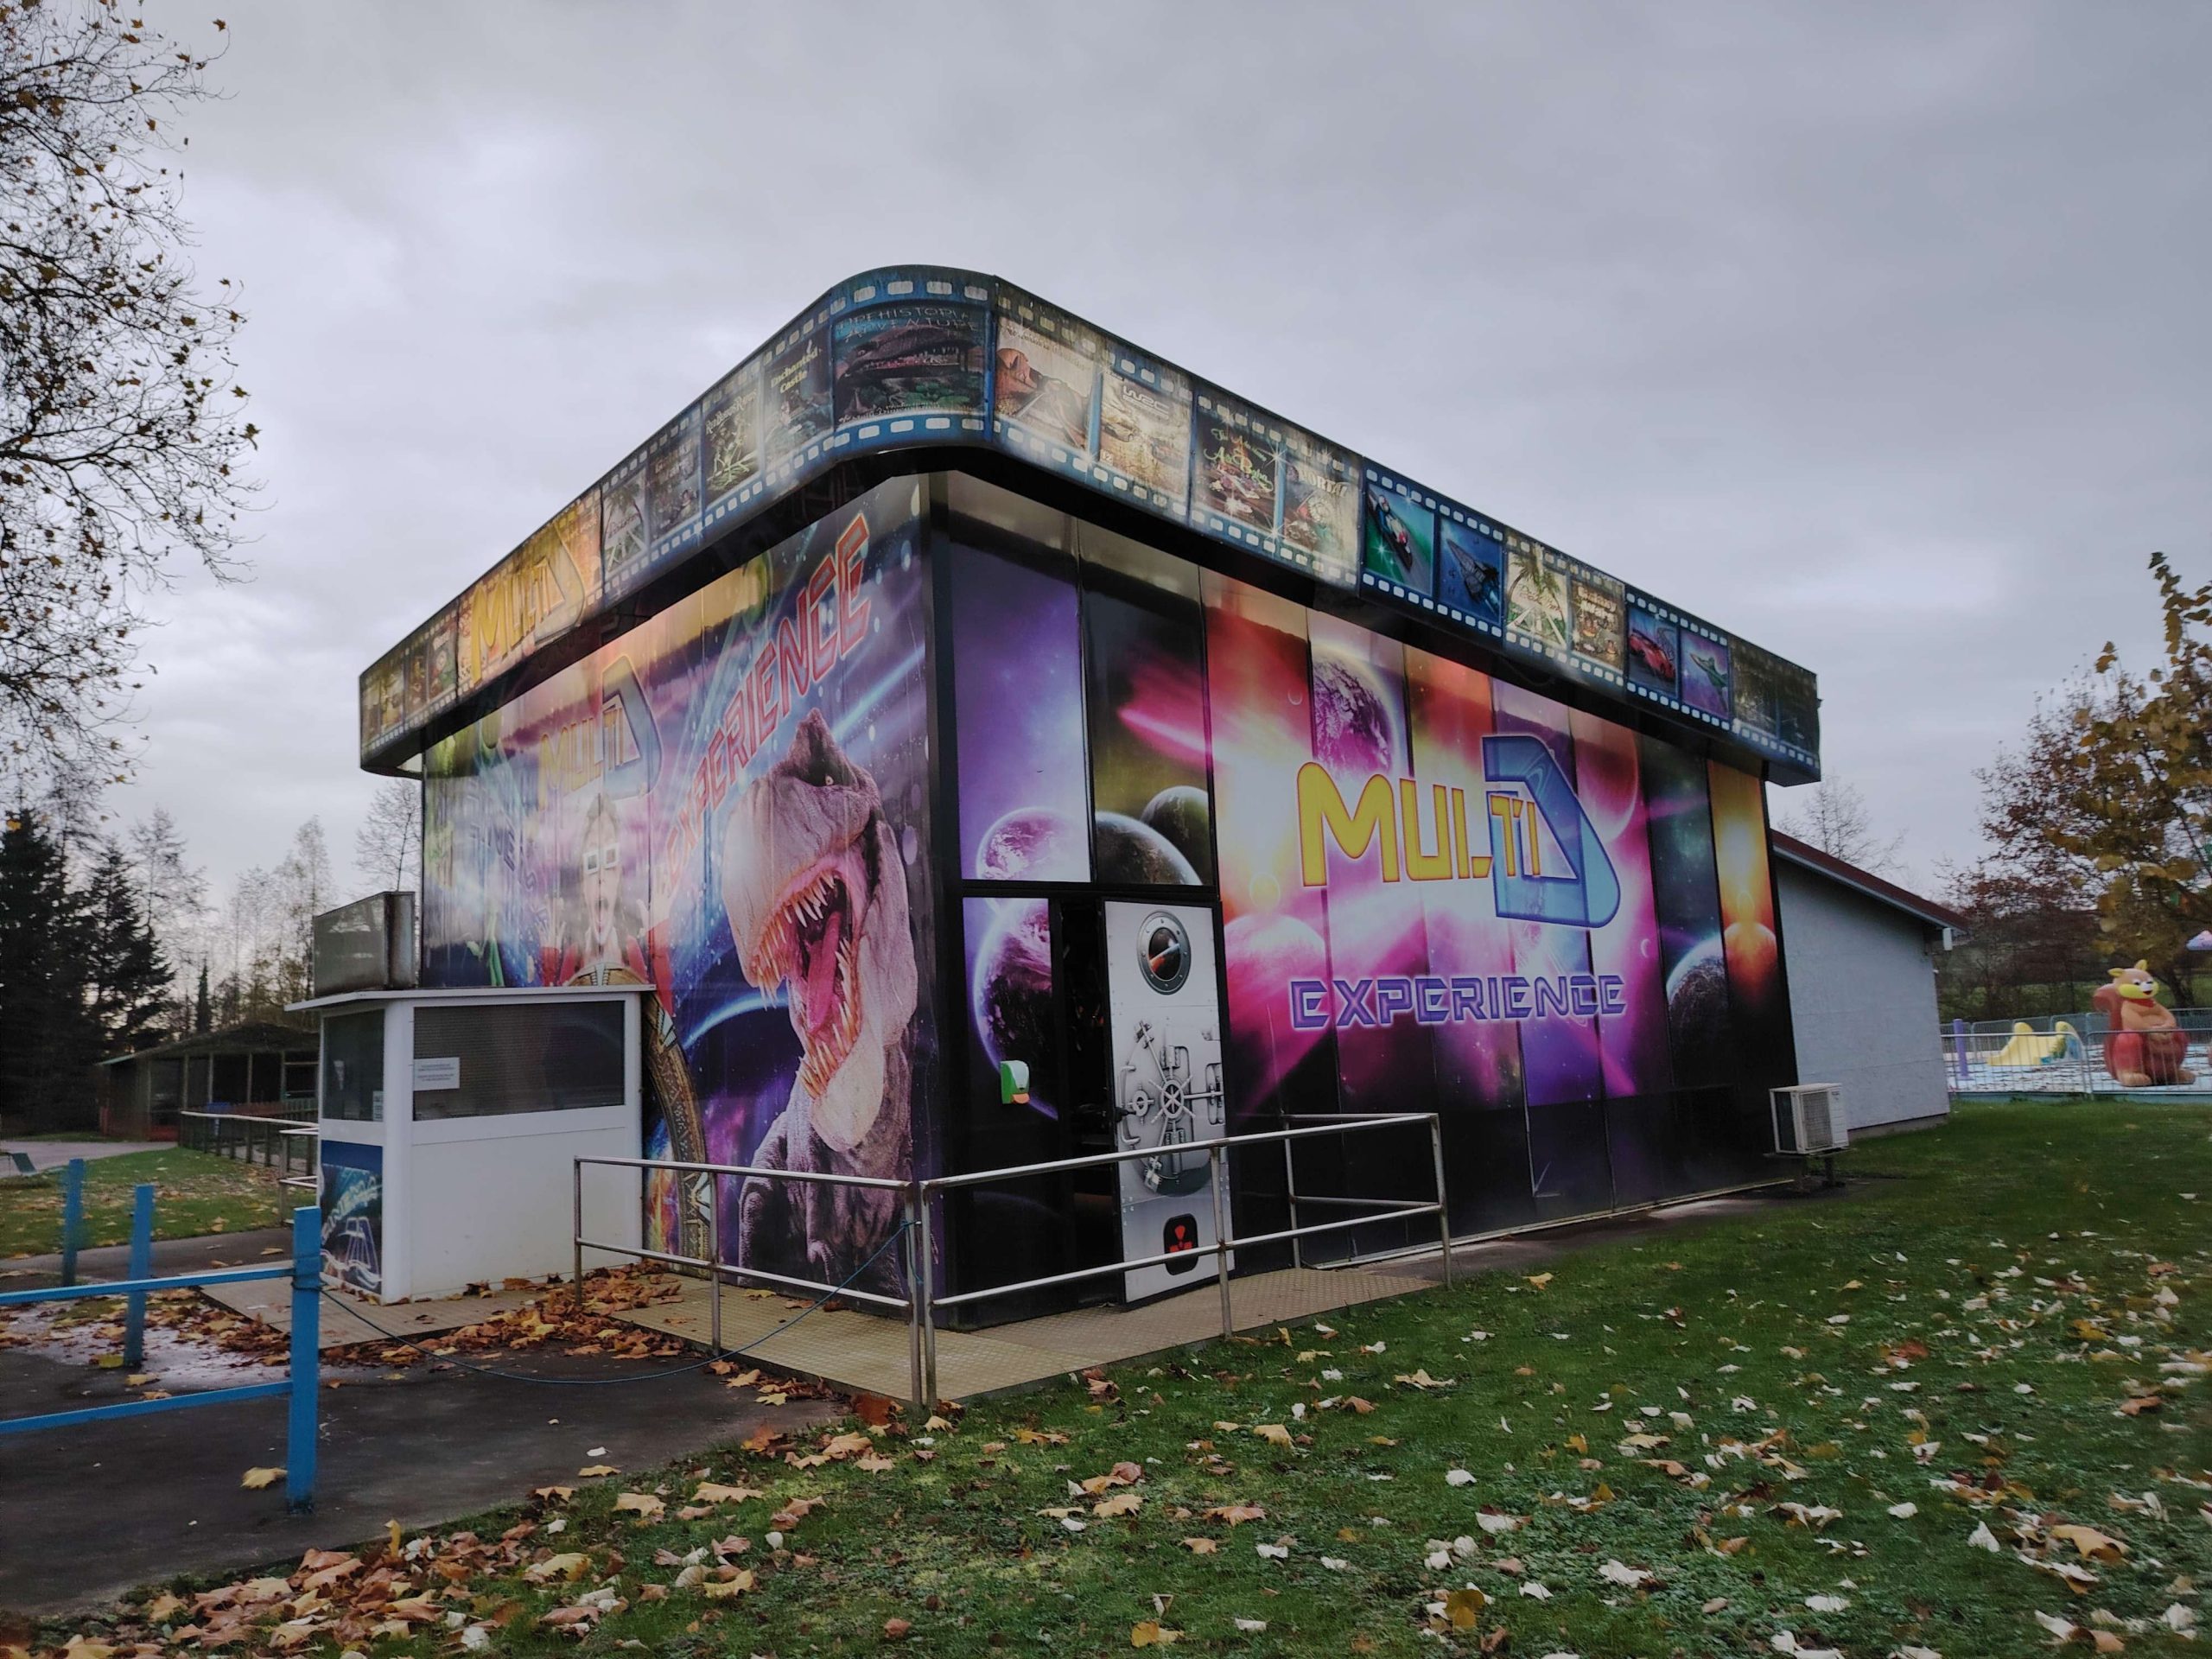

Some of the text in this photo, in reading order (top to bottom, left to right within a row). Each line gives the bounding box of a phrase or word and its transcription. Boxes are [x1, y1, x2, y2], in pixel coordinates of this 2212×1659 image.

[771, 346, 818, 388] Enchanted
[779, 371, 808, 393] Castle
[1122, 385, 1169, 416] WRC
[665, 512, 871, 881] EXPERIENCE
[1296, 760, 1541, 888] MULTI
[1289, 974, 1627, 1029] EXPERIENCE
